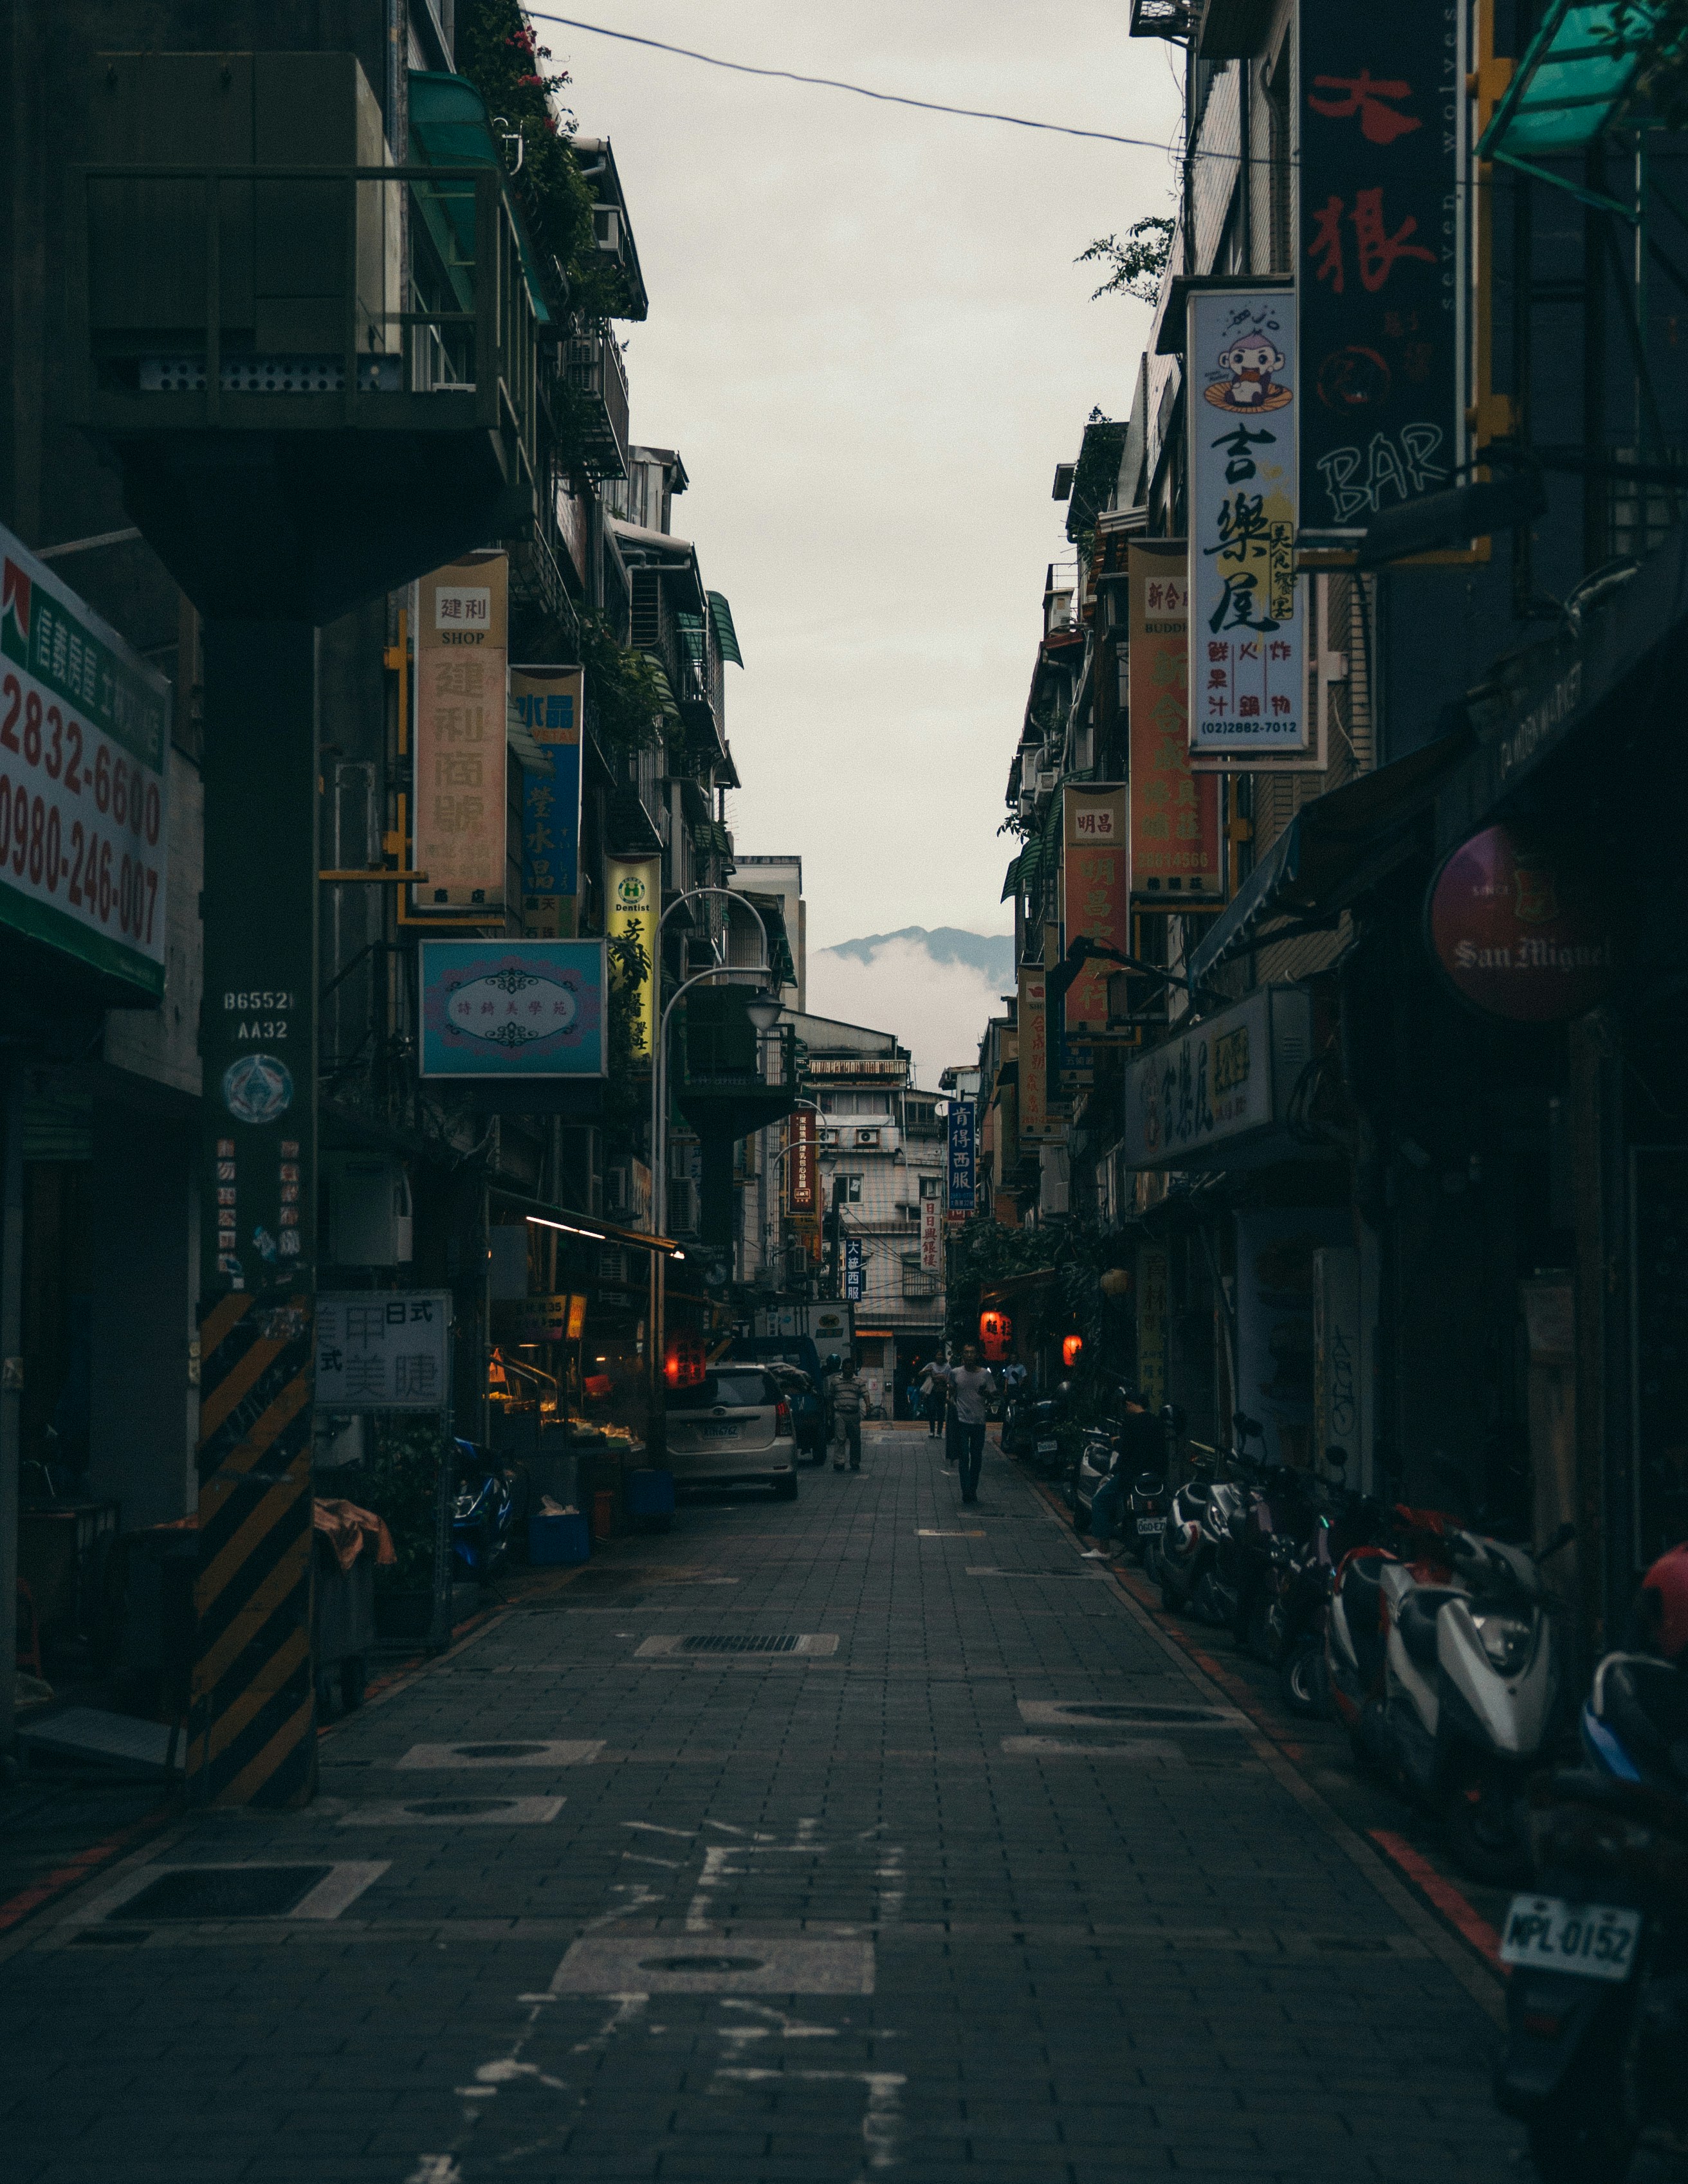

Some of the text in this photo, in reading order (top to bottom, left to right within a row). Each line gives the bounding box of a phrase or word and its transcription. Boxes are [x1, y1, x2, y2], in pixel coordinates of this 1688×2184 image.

[1316, 422, 1449, 522] BAR
[1204, 422, 1280, 634] 吉樂屋
[441, 598, 487, 619] 建利
[1148, 582, 1188, 610] 新合
[441, 632, 484, 644] SHOP
[1207, 641, 1228, 716] 鮮果汁
[516, 694, 573, 729] 水晶
[1202, 721, 1296, 734] (02)2882-7012
[526, 749, 556, 891] 瑩水晶
[1078, 814, 1112, 833] 明昌
[1454, 939, 1510, 969] San
[237, 1022, 288, 1039] AA32
[952, 1106, 972, 1189] 肯得西服
[922, 1203, 937, 1267] 日日興銀樓
[847, 1241, 859, 1300] 大統西服
[387, 1300, 434, 1324] 日式
